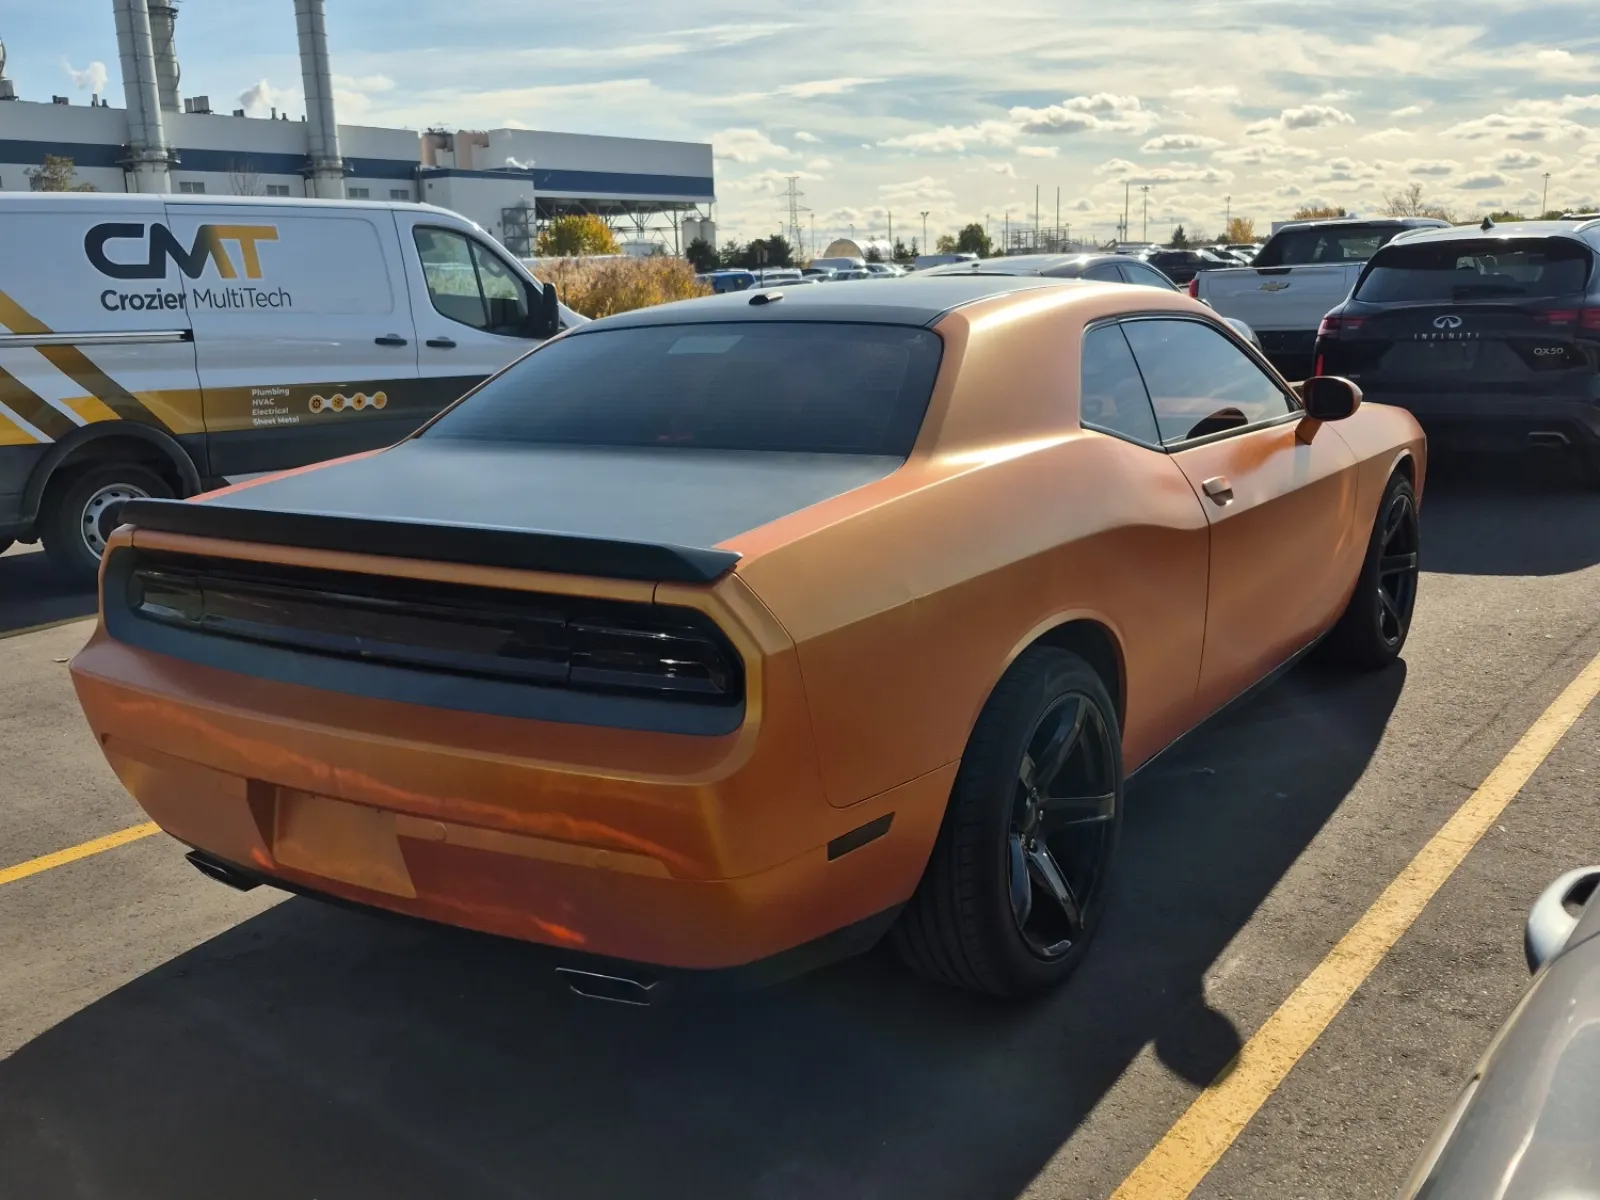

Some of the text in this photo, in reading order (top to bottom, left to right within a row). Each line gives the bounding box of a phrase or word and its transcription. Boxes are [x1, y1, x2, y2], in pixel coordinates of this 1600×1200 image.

[84, 222, 279, 279] CMT
[100, 287, 292, 312] Crozier MultiTech
[1413, 332, 1480, 340] INFINITI
[1533, 347, 1564, 356] QX50
[251, 387, 290, 397] Plumbing
[252, 398, 275, 406] HVAC
[252, 407, 289, 416] Electrical
[253, 416, 300, 426] Sheet Metal
